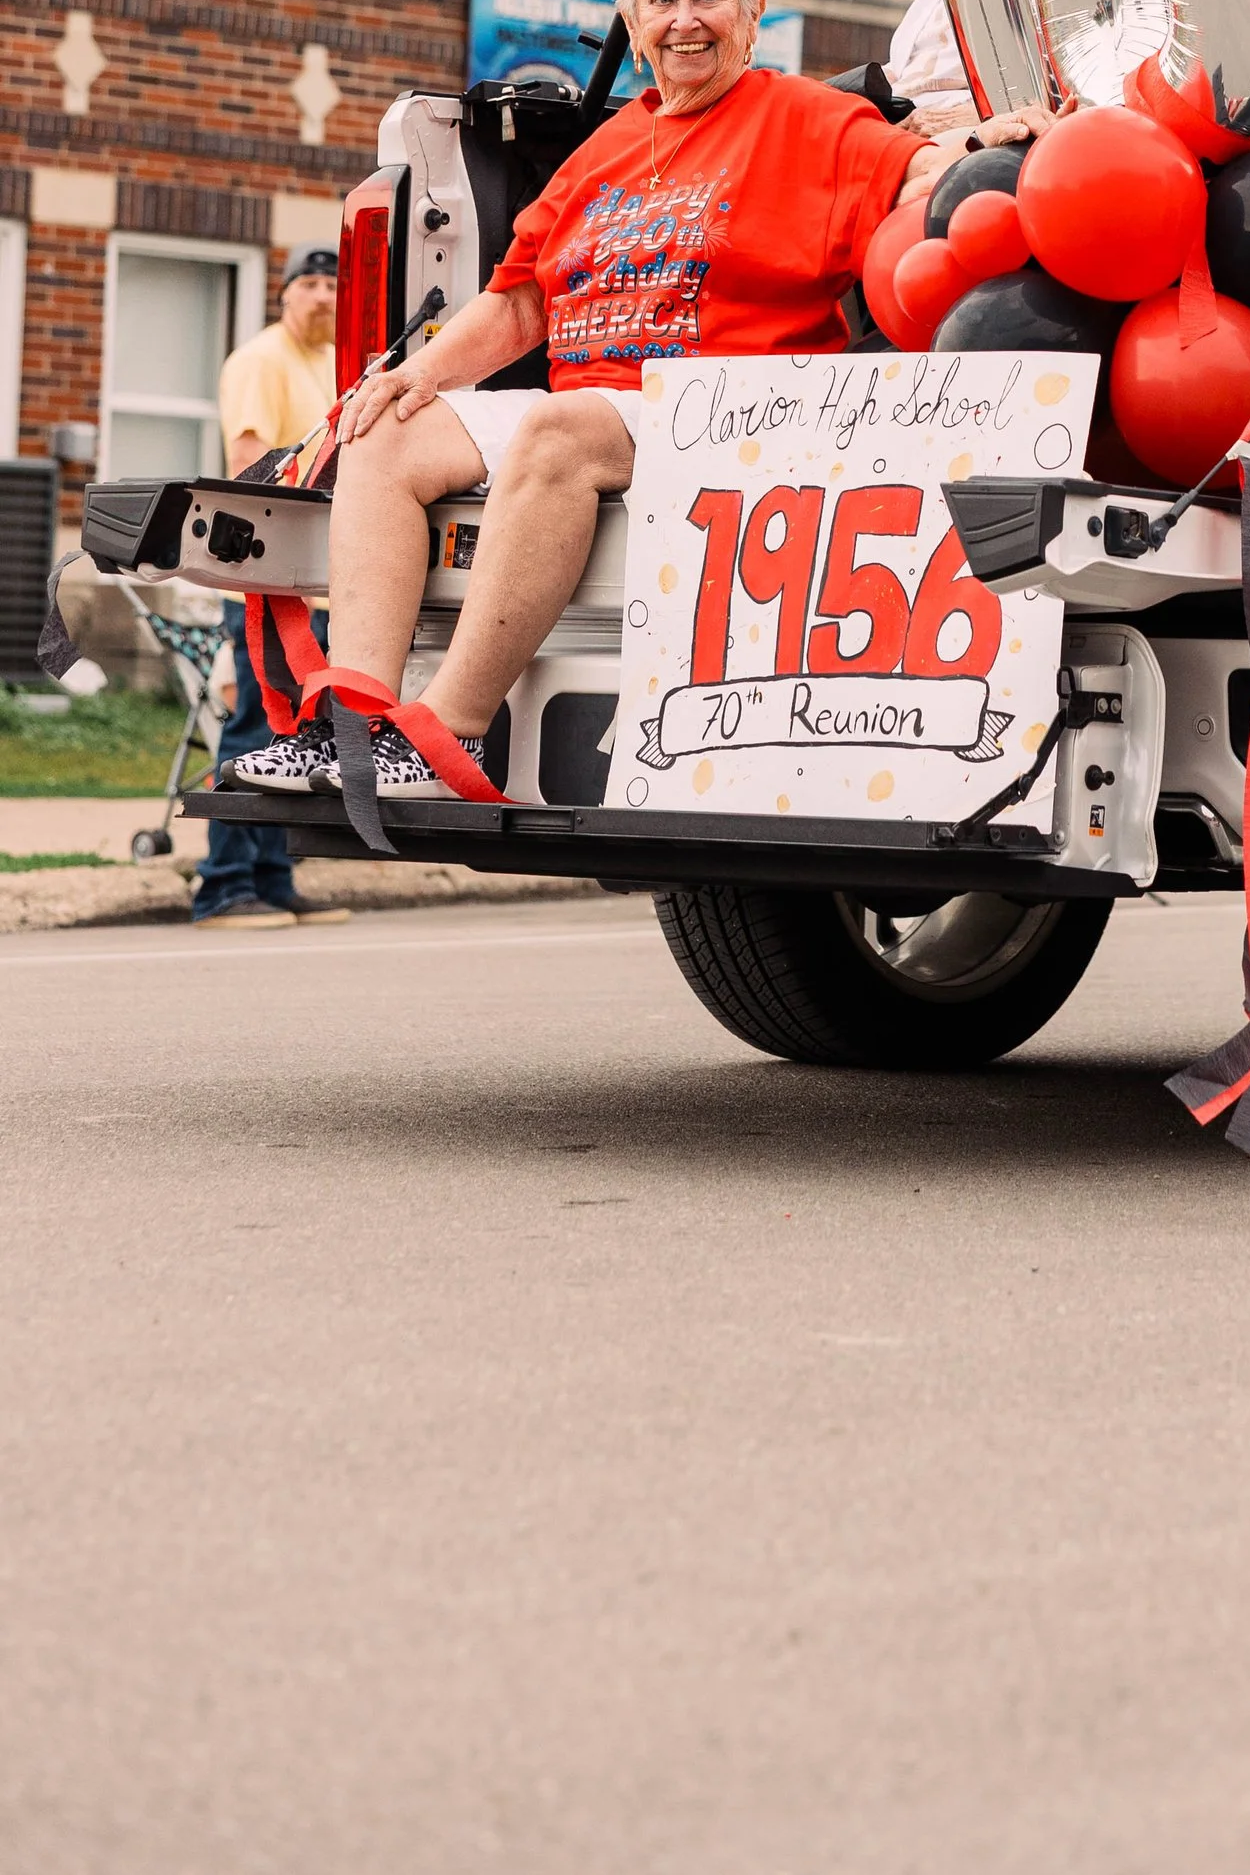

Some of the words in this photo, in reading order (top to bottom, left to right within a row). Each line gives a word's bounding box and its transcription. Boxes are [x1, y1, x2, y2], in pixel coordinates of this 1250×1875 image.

[671, 368, 808, 451] Clarion
[812, 365, 880, 450] High
[889, 356, 1023, 431] School
[685, 484, 1003, 686] 1956
[701, 687, 763, 740] 70th
[788, 682, 926, 740] Reunion
